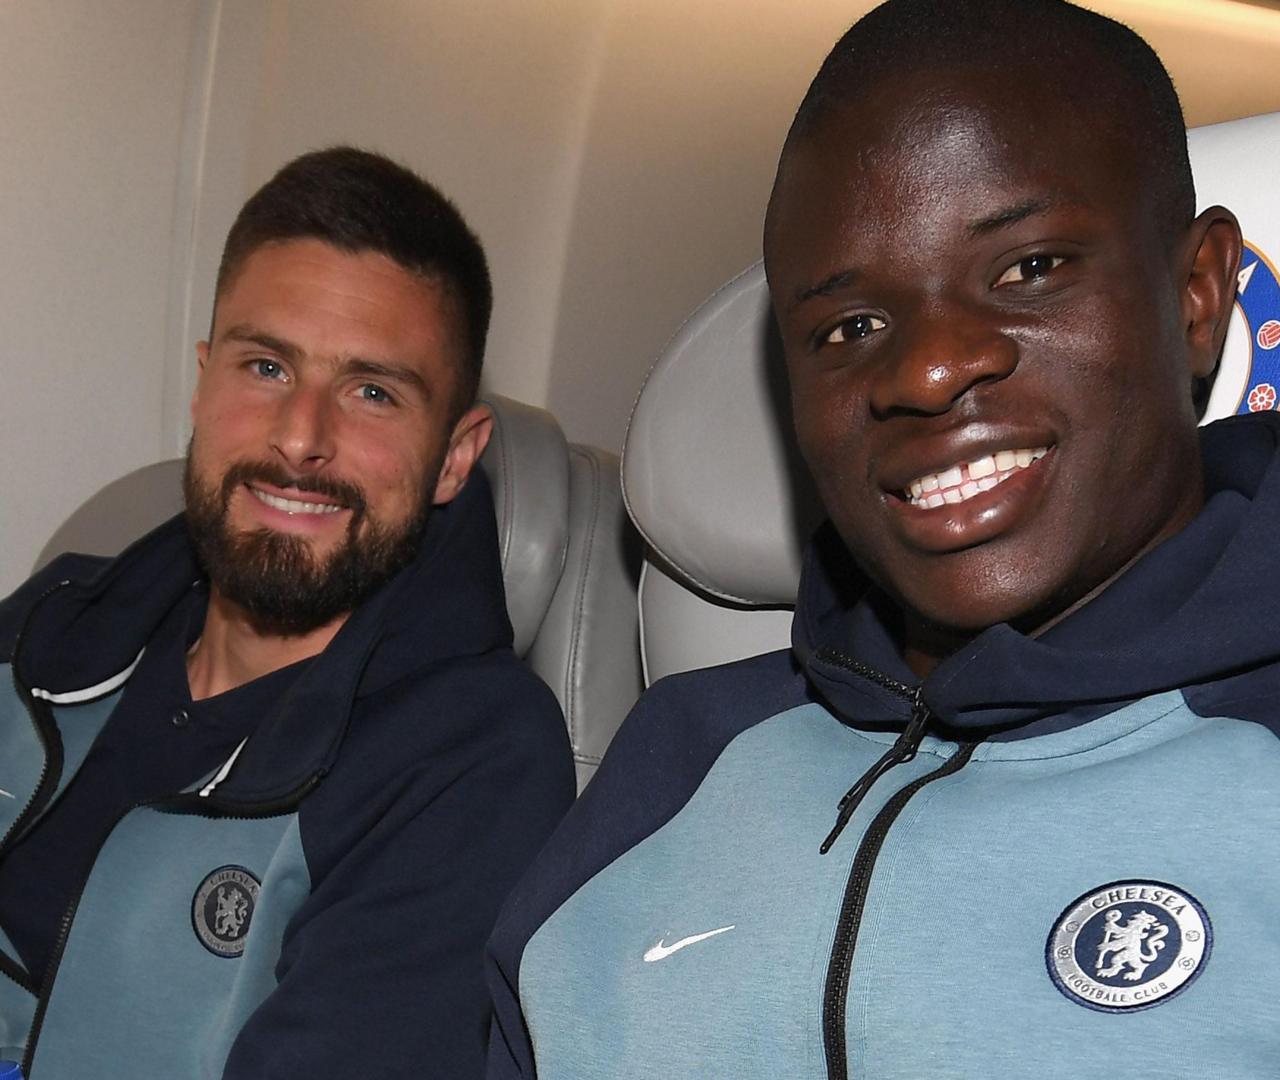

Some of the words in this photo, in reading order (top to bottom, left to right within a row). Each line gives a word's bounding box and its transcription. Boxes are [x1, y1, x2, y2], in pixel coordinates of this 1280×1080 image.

[1092, 887, 1188, 916] CHELSEA
[1068, 972, 1127, 1003] FOOTBALL
[1134, 981, 1169, 1001] CLUB
